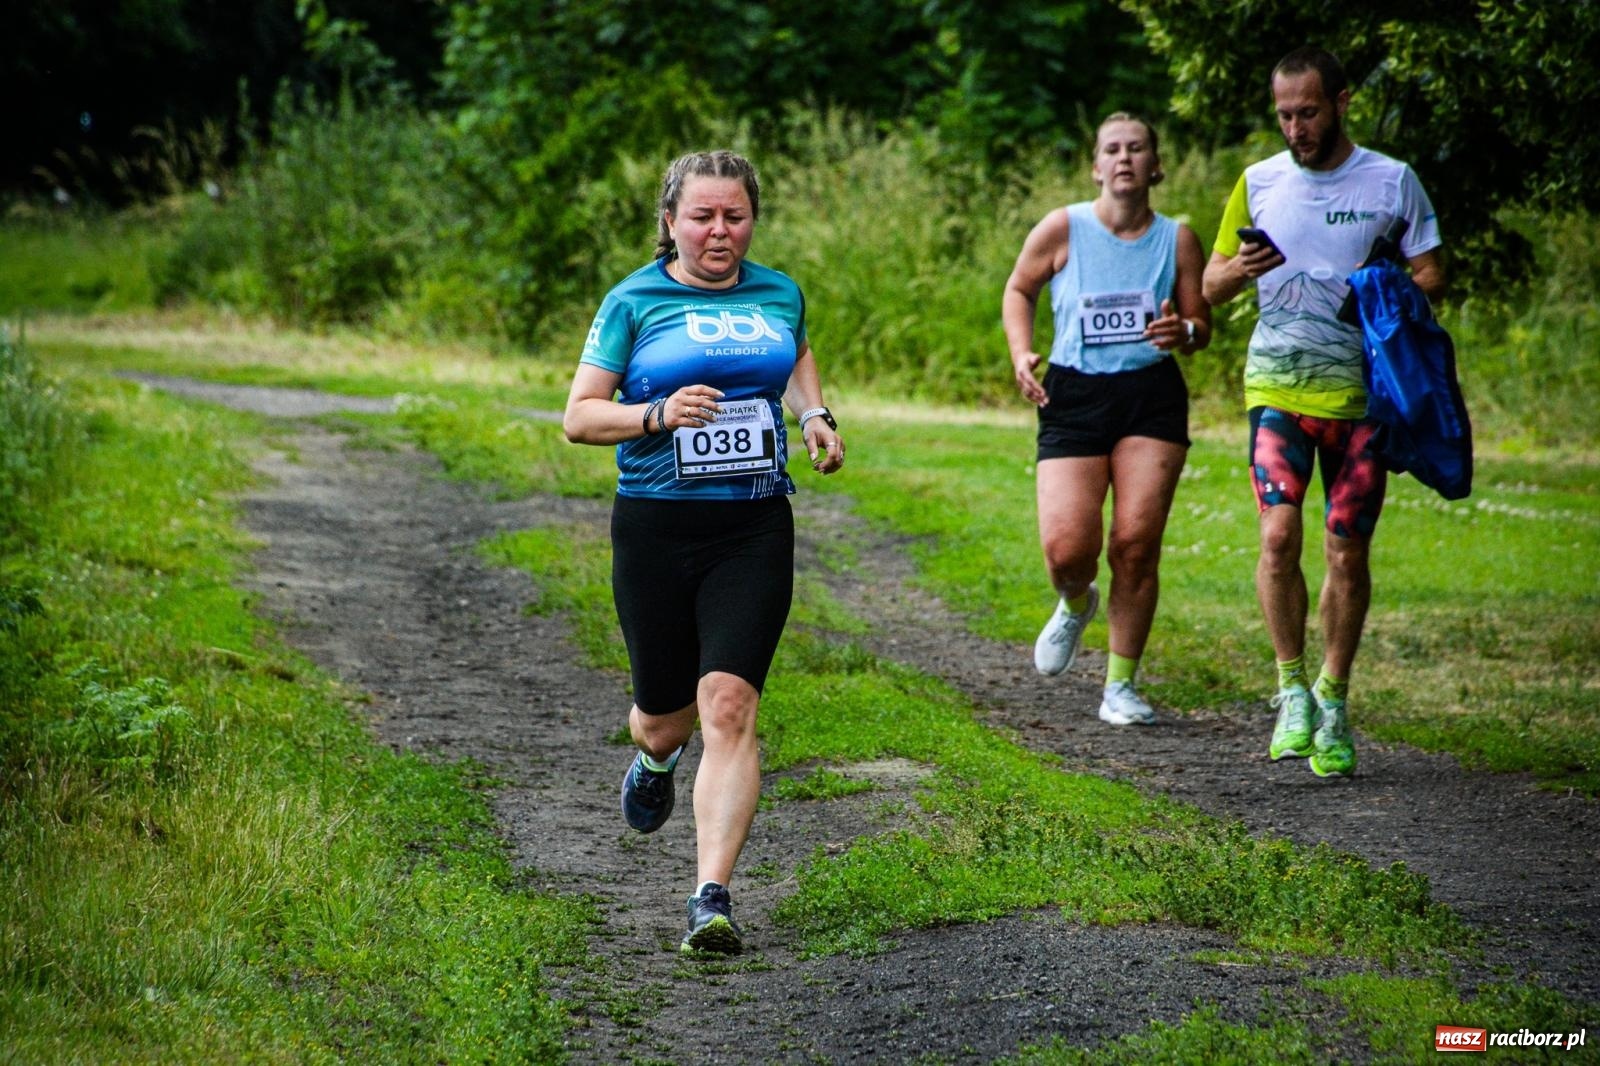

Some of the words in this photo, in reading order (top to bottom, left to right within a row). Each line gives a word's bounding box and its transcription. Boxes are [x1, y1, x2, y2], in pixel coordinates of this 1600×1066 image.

[1326, 209, 1358, 225] UTA
[1092, 311, 1136, 330] 003
[705, 346, 768, 356] RACIBÓRZ
[729, 405, 758, 415] PIĄTKĘ
[692, 428, 752, 456] 038
